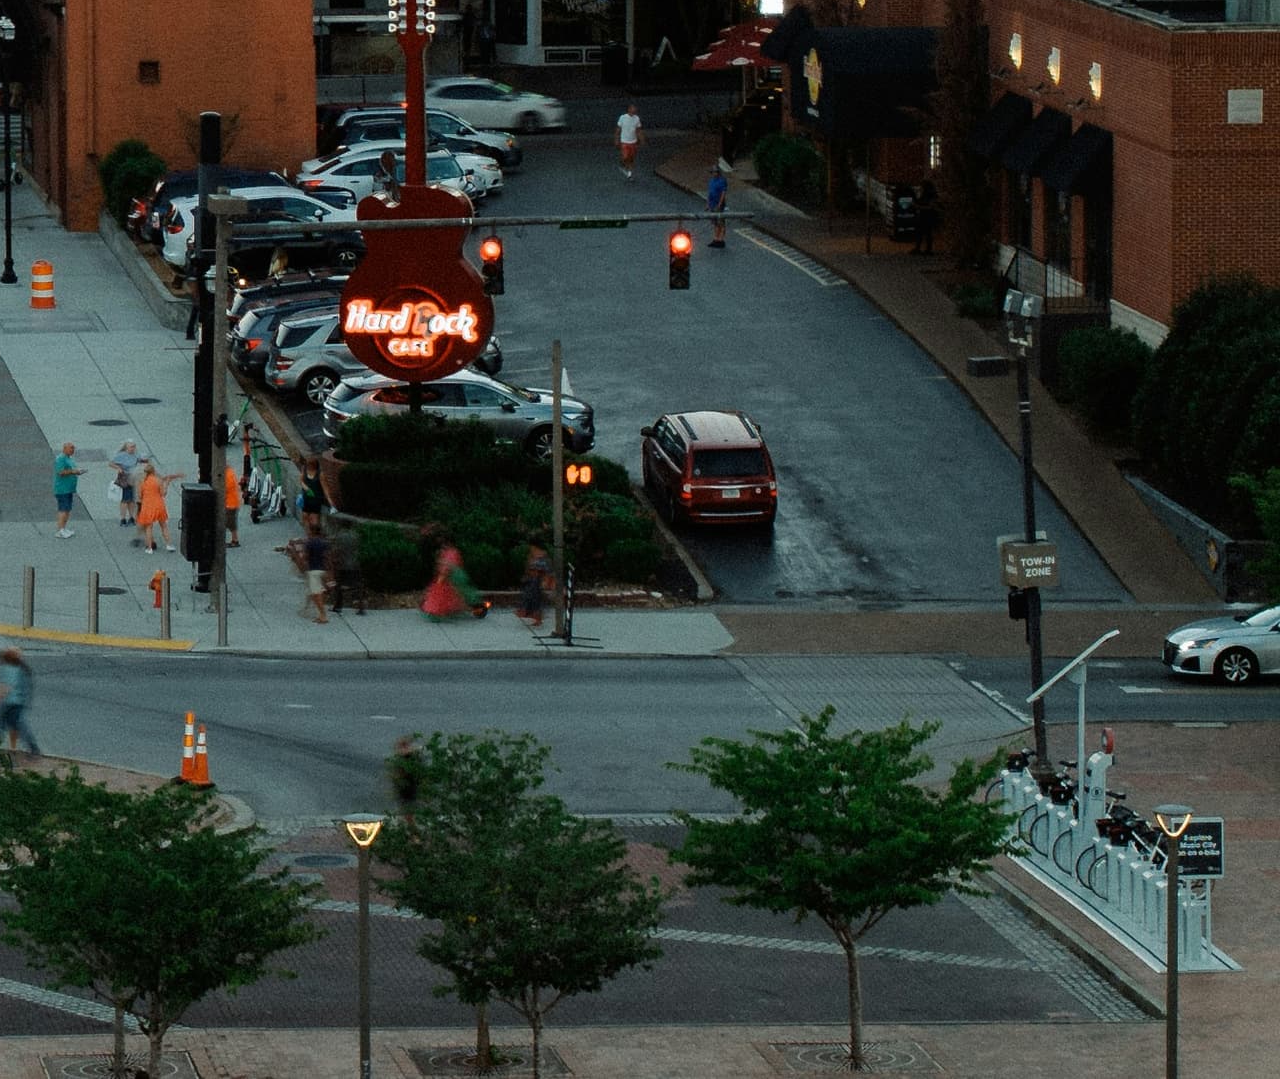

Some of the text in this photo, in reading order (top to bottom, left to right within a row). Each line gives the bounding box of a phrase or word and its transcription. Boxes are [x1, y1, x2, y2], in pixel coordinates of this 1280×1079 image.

[346, 299, 478, 342] Hard Rock
[388, 338, 433, 356] CAFE
[1020, 555, 1055, 567] TOW-IN
[1024, 566, 1052, 578] ZONE
